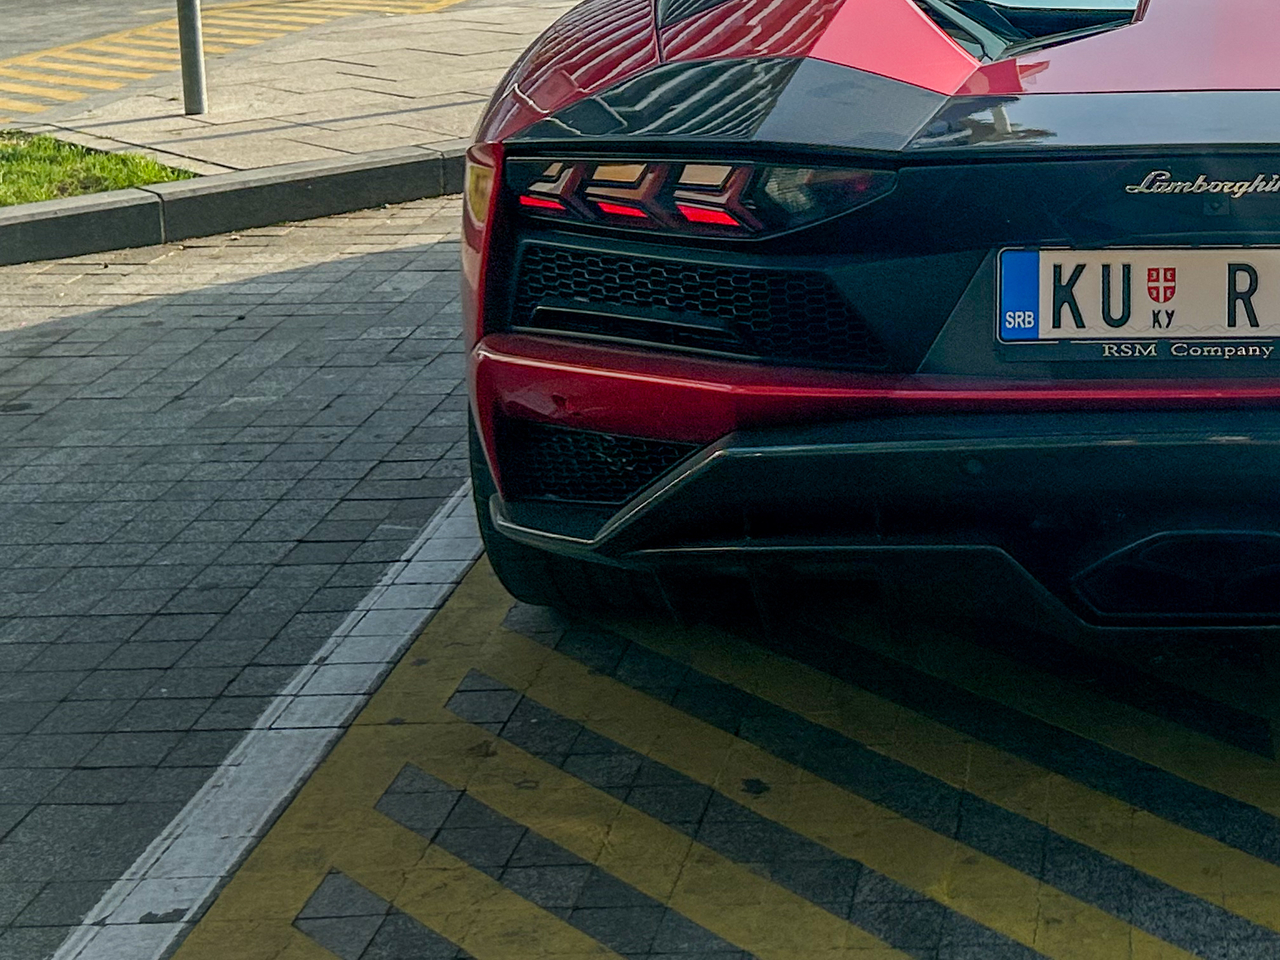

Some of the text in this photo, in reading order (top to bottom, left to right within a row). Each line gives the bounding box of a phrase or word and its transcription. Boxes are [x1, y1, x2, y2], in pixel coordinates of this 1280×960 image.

[1052, 263, 1131, 329] KU
[1005, 310, 1035, 329] SRB
[1102, 343, 1274, 359] RSM Company
